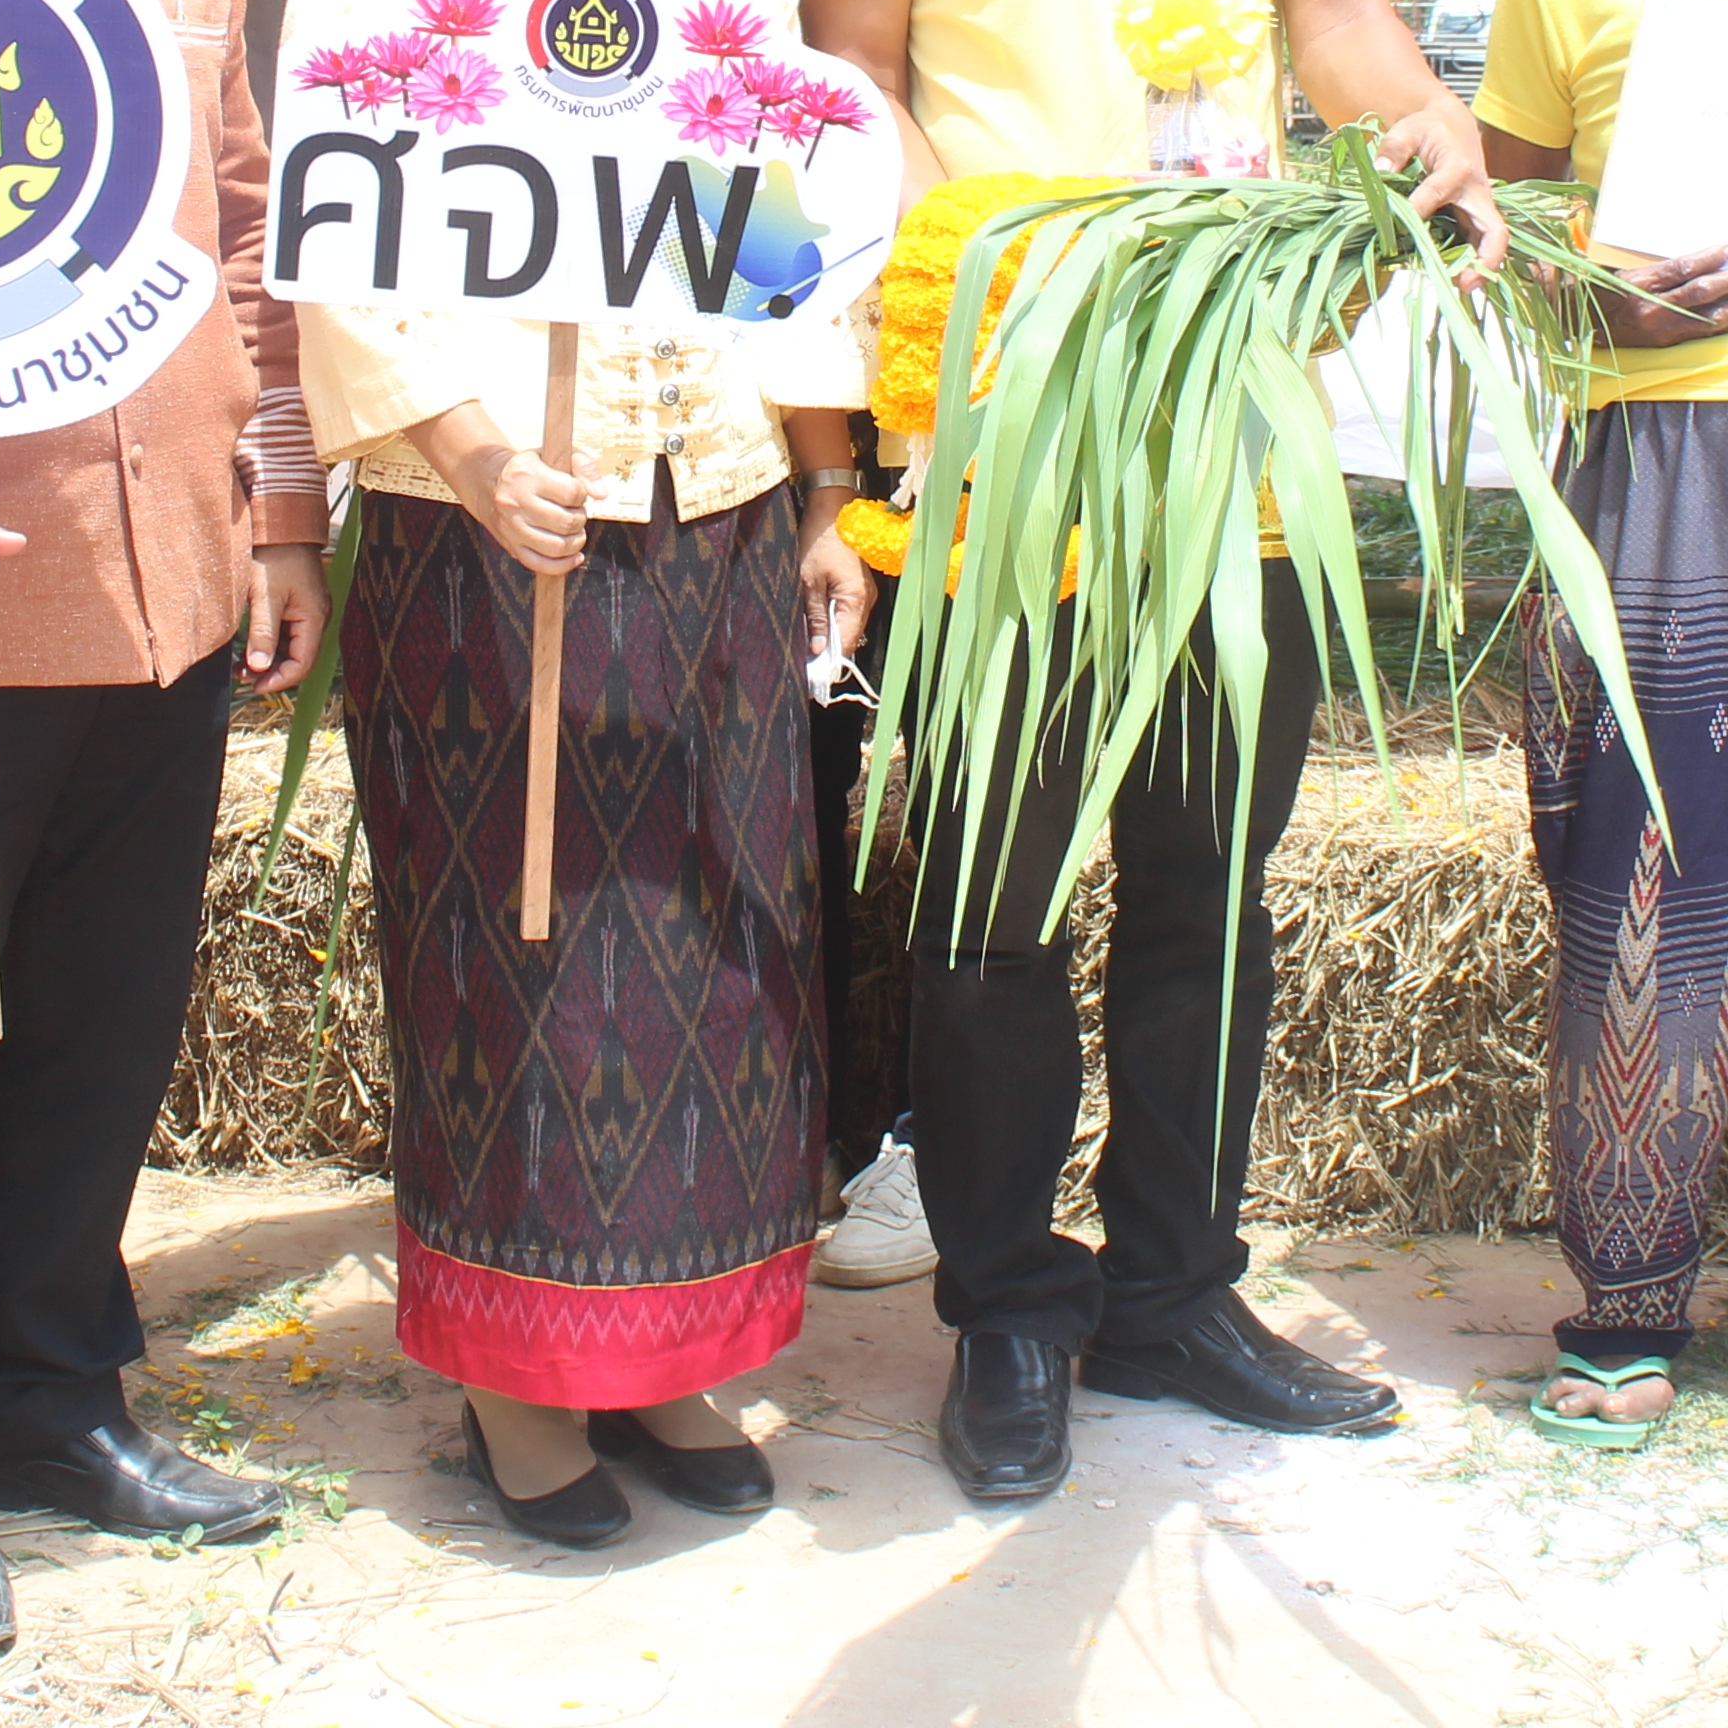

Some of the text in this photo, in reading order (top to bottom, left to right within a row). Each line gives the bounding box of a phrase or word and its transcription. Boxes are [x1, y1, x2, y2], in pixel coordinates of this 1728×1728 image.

[513, 65, 664, 118] กรมการพัฒนาชุมชน
